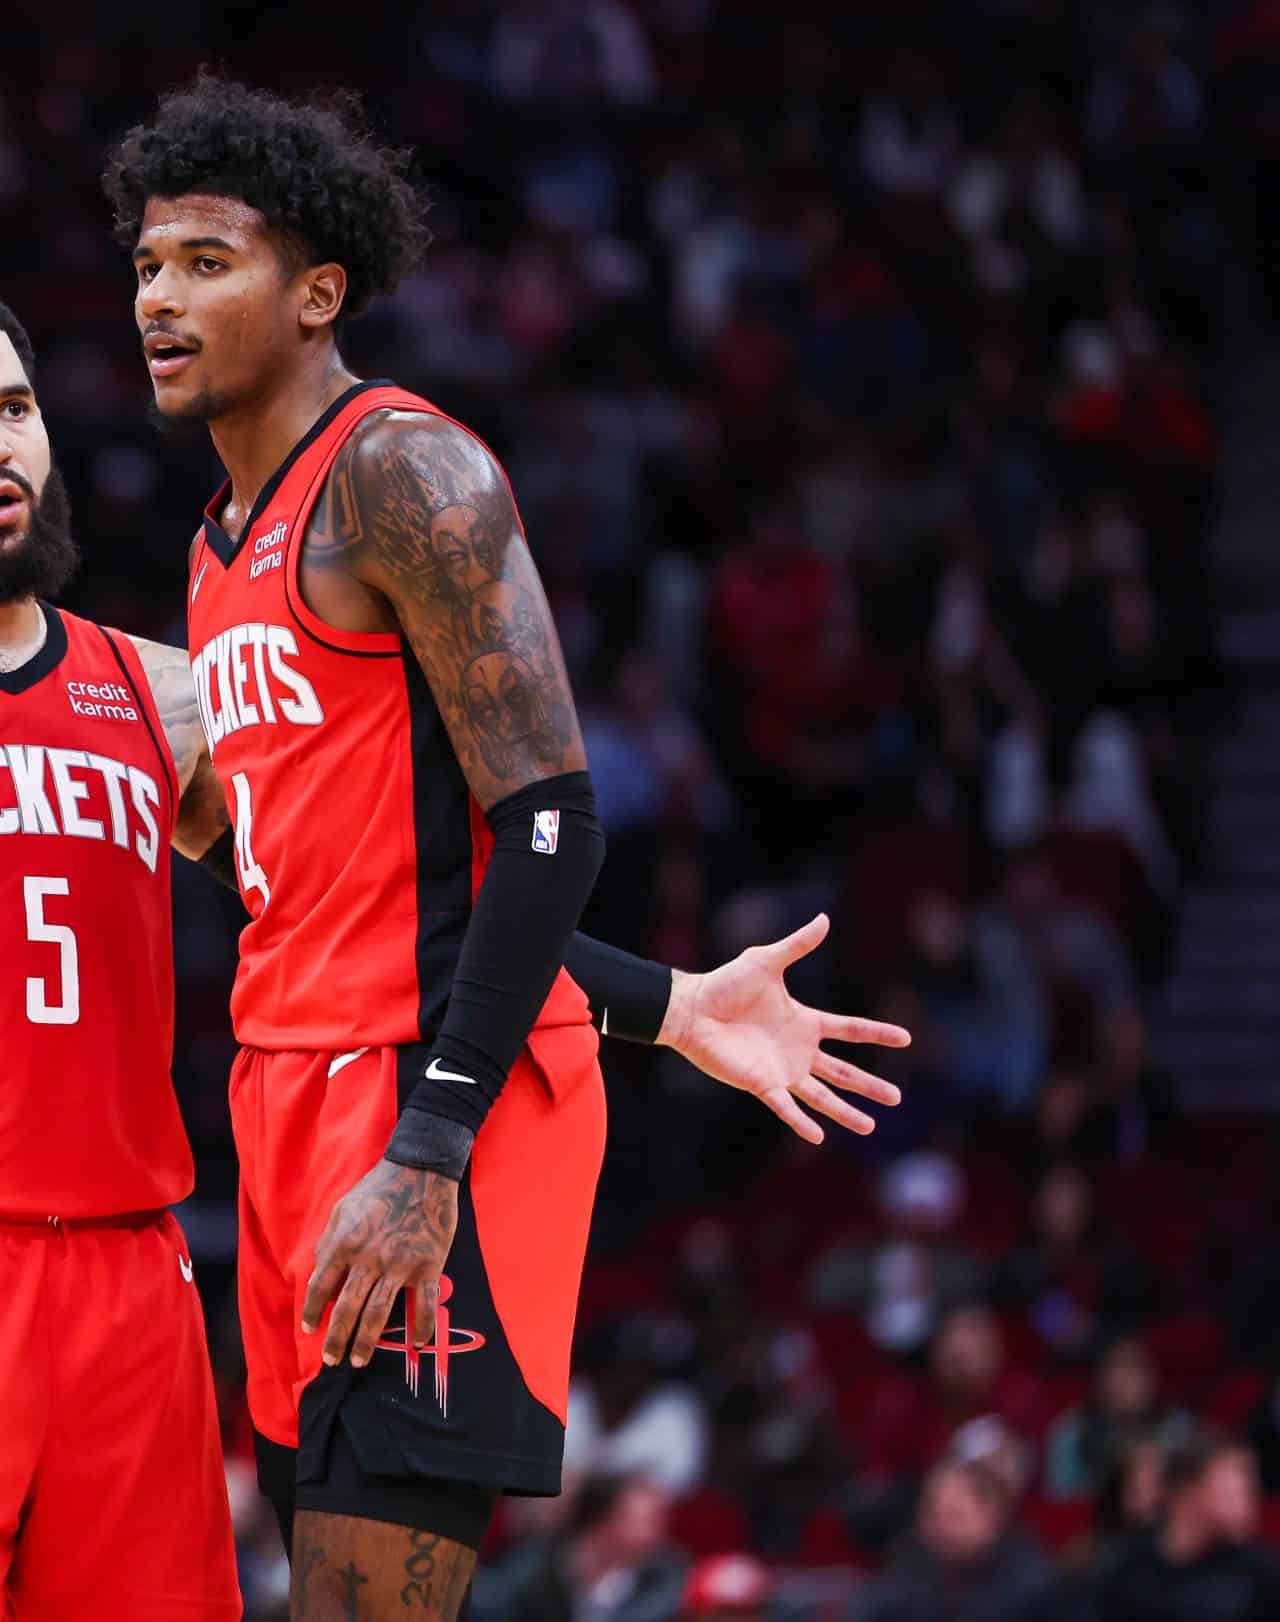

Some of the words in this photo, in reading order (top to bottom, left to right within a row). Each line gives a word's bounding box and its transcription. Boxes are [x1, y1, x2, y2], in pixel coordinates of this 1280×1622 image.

[255, 521, 288, 554] credit
[249, 550, 282, 580] karma
[67, 681, 131, 702] credit
[68, 694, 139, 721] karma
[191, 622, 325, 766] OCKETS
[231, 770, 271, 910] 4
[23, 875, 80, 1025] 5
